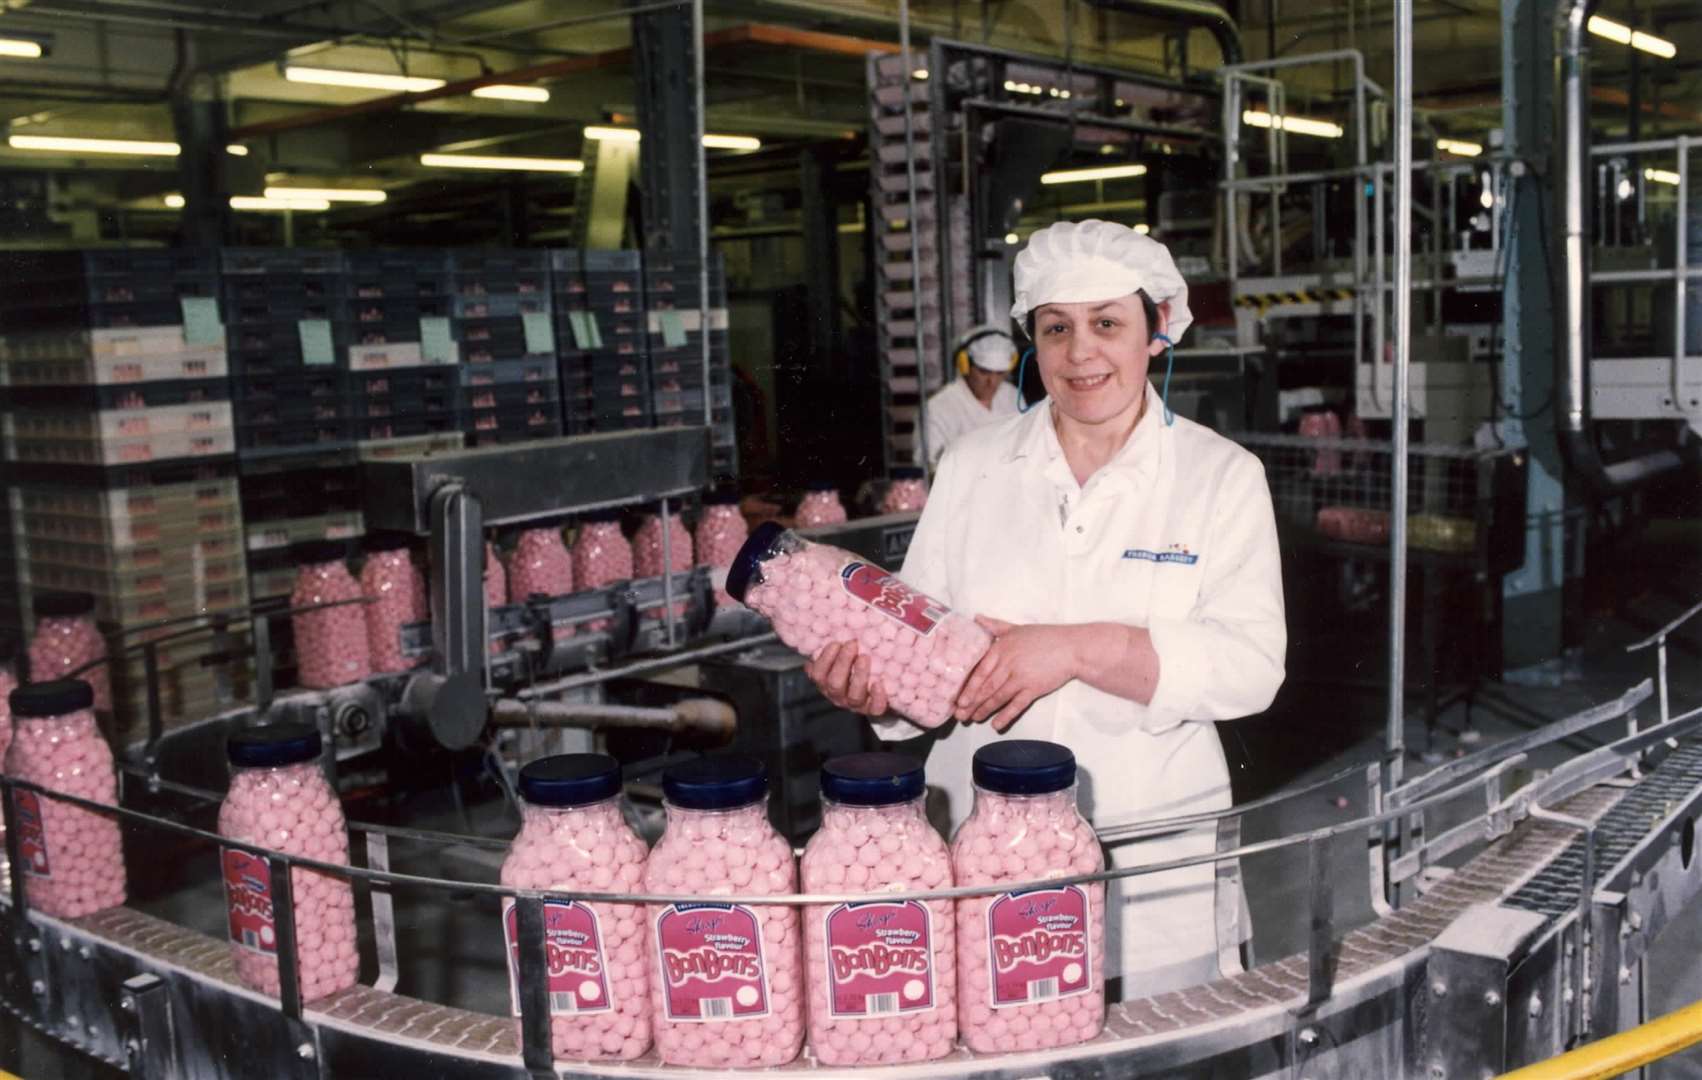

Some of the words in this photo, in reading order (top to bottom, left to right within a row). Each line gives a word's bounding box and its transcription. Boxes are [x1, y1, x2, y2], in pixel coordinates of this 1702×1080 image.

[1037, 913, 1079, 926] Strawberry
[704, 933, 751, 946] Strawberry
[875, 928, 921, 940] Strawberry
[831, 944, 929, 981] BonBons
[993, 930, 1086, 971] BonBons
[664, 948, 761, 985] BonBons
